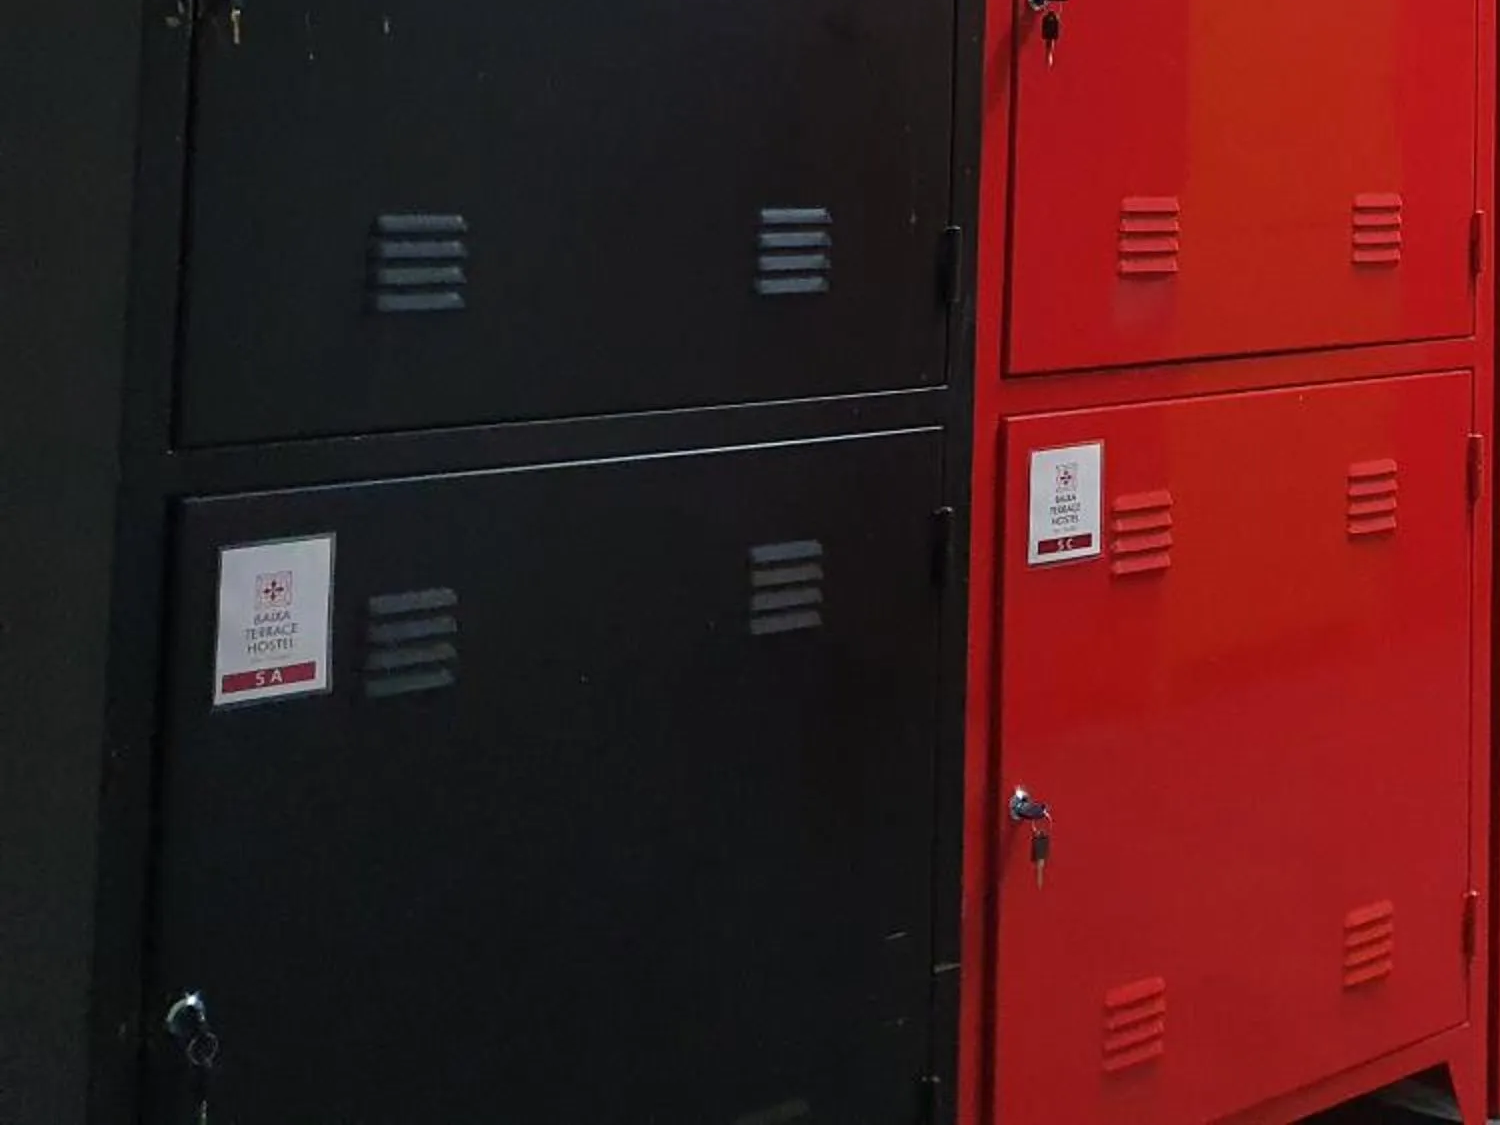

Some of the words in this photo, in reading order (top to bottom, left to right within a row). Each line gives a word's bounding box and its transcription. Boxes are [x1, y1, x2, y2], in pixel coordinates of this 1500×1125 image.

[254, 610, 291, 625] BAIXA
[244, 622, 299, 641] TERRACE
[247, 638, 295, 654] HOSTEL
[270, 668, 283, 683] A
